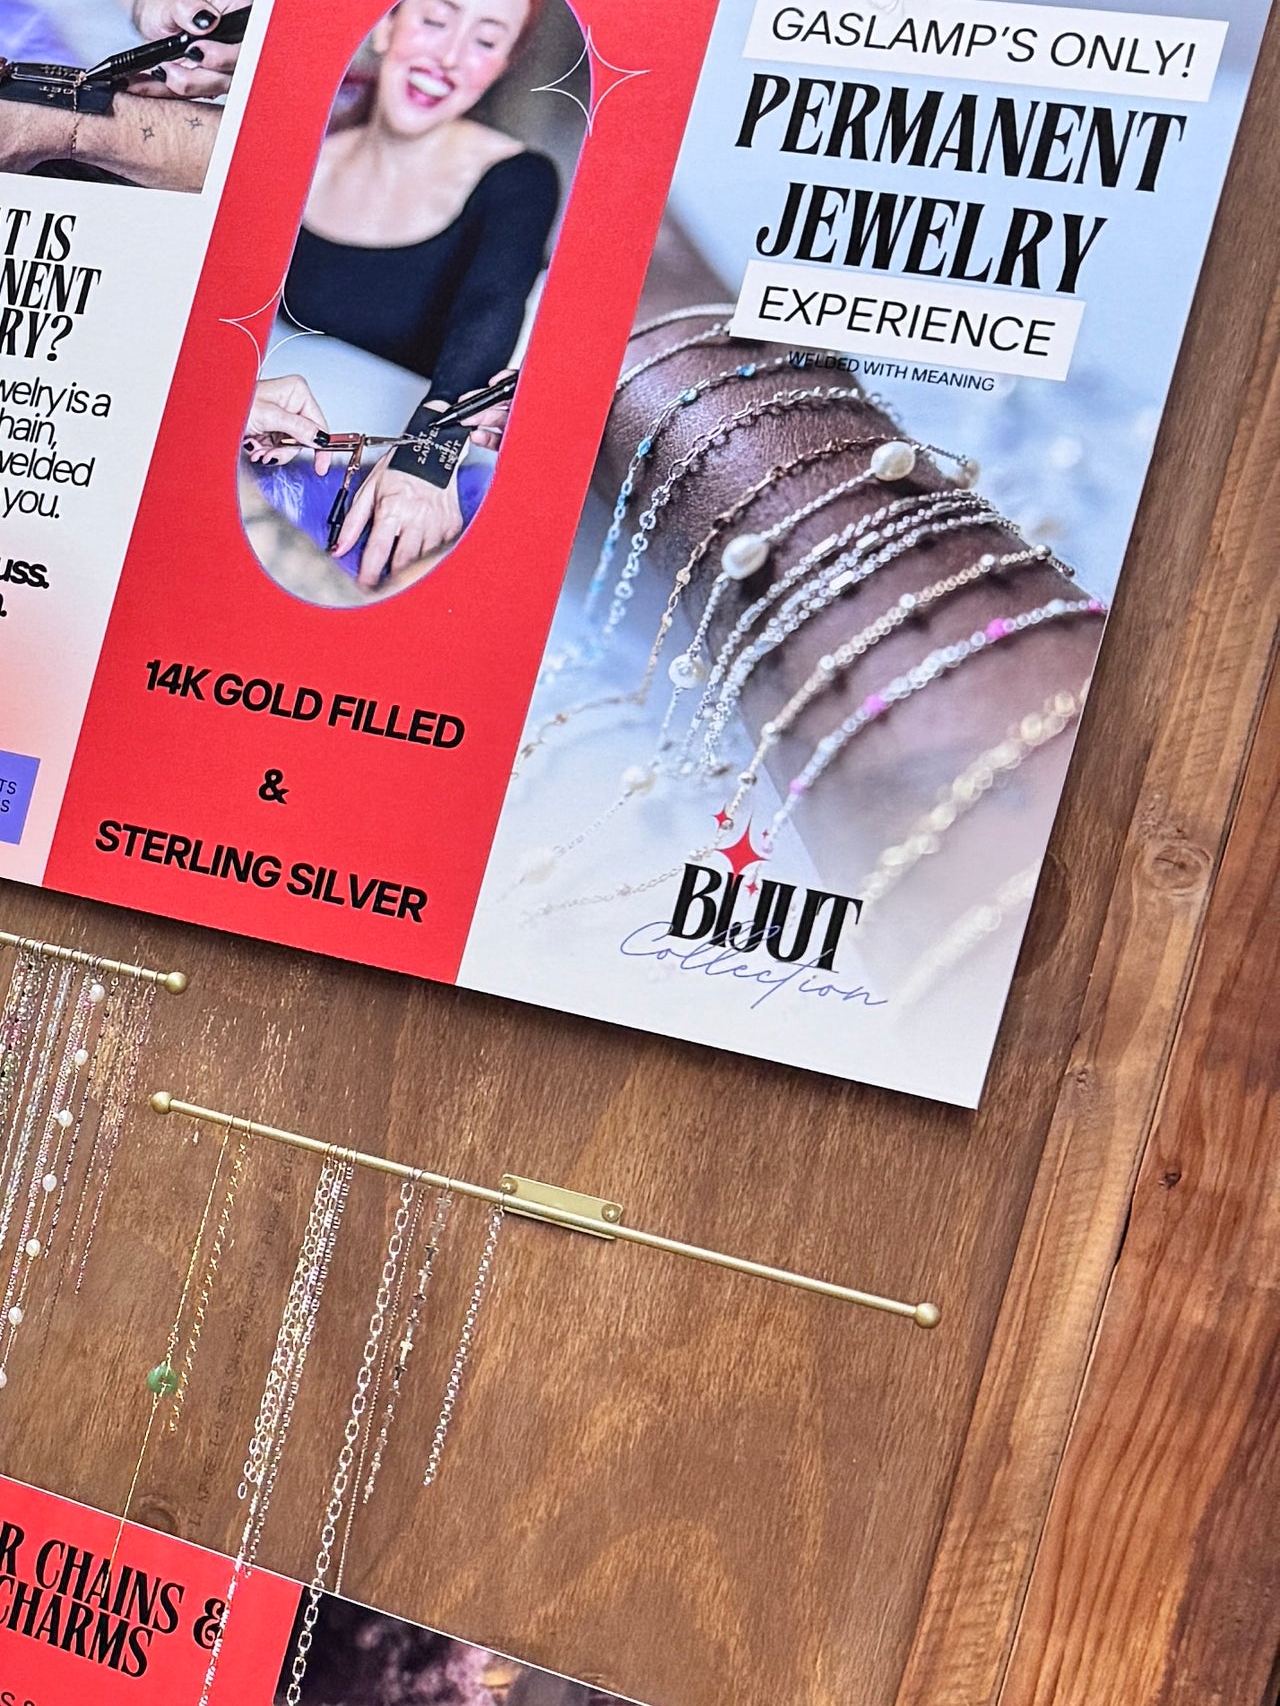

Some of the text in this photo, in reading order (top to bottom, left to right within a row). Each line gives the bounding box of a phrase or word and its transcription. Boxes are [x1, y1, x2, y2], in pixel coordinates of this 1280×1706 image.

[772, 6, 1196, 78] GASLAMP'S ONLY!
[734, 72, 1188, 193] PERMANENT
[34, 213, 77, 262] IS
[755, 181, 1108, 294] JEWELRY
[758, 285, 1056, 357] EXPERIENCE
[65, 382, 90, 414] is
[91, 393, 112, 418] a
[788, 351, 995, 392] WELDED WITH MEANING
[2, 487, 60, 519] you.
[146, 659, 465, 749] 14K GOLD FILLED
[258, 768, 289, 805] &
[95, 820, 428, 923] STERLING SILVER
[669, 862, 865, 974] BIJUT
[619, 920, 889, 1010] Collection
[34, 1538, 185, 1636] CHAINS
[192, 1597, 229, 1652] &
